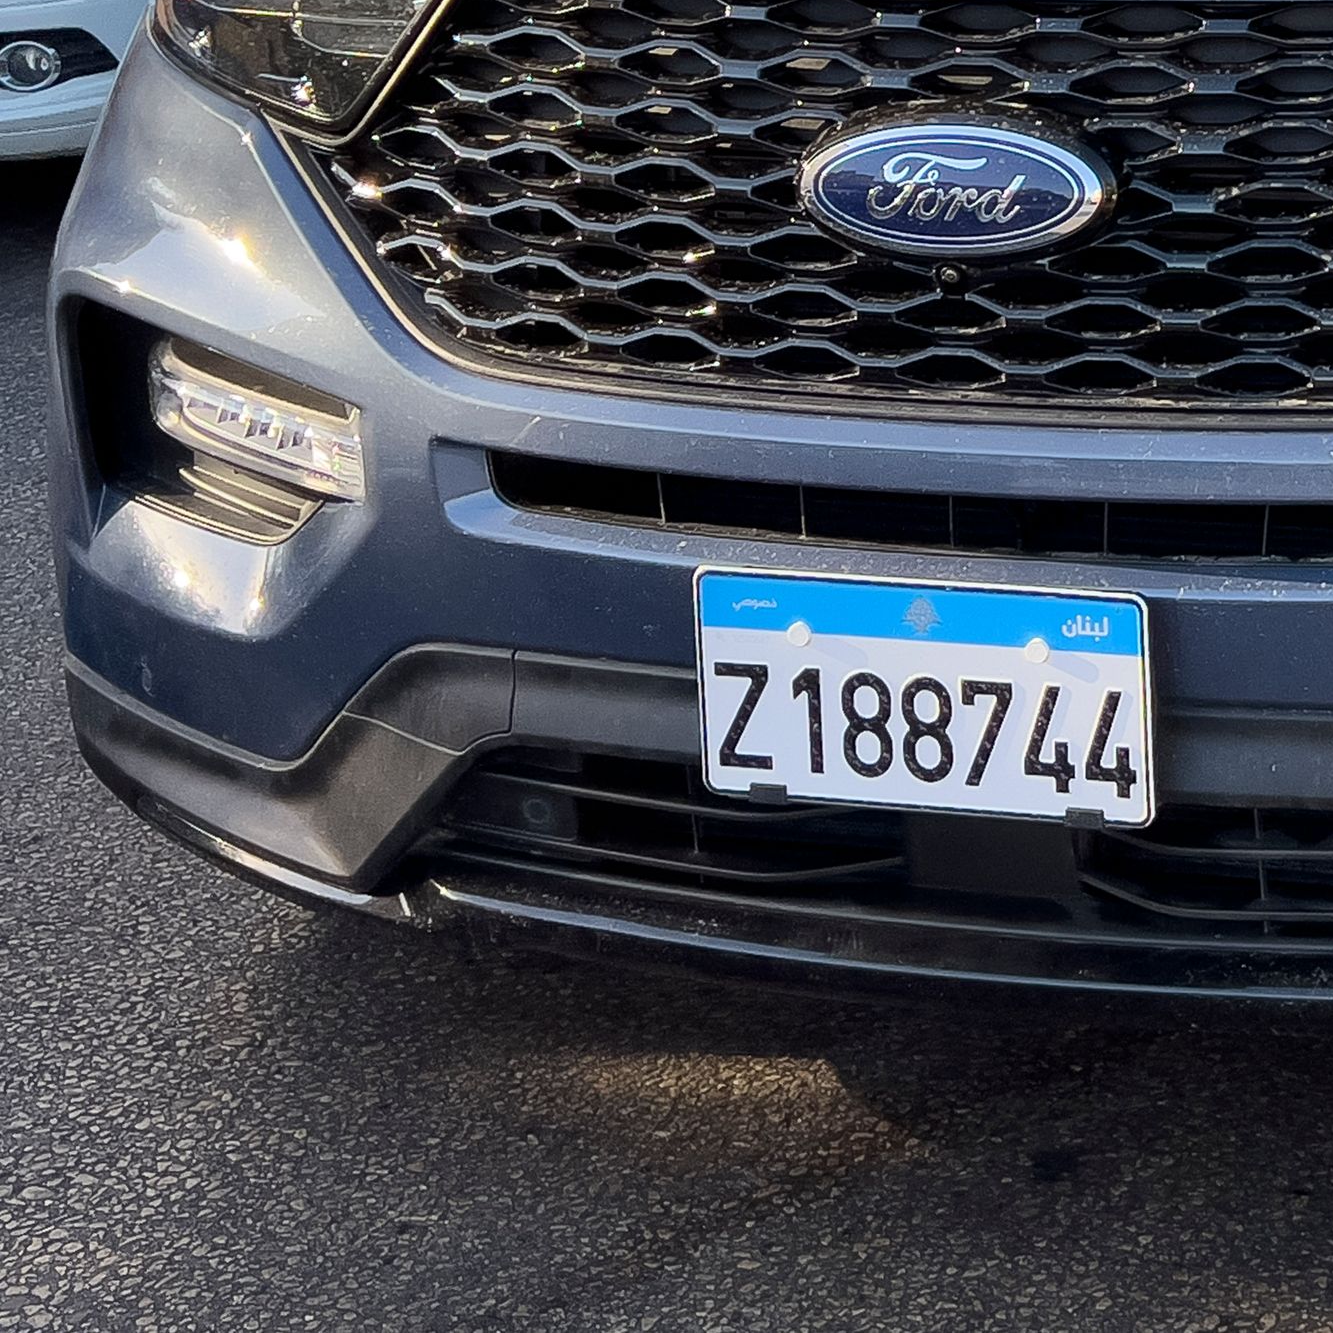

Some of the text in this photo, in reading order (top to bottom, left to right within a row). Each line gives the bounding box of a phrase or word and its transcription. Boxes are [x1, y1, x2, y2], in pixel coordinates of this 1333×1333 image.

[866, 151, 1027, 224] Ford
[1061, 614, 1109, 643] لبنان
[713, 662, 1137, 799] Z188744
